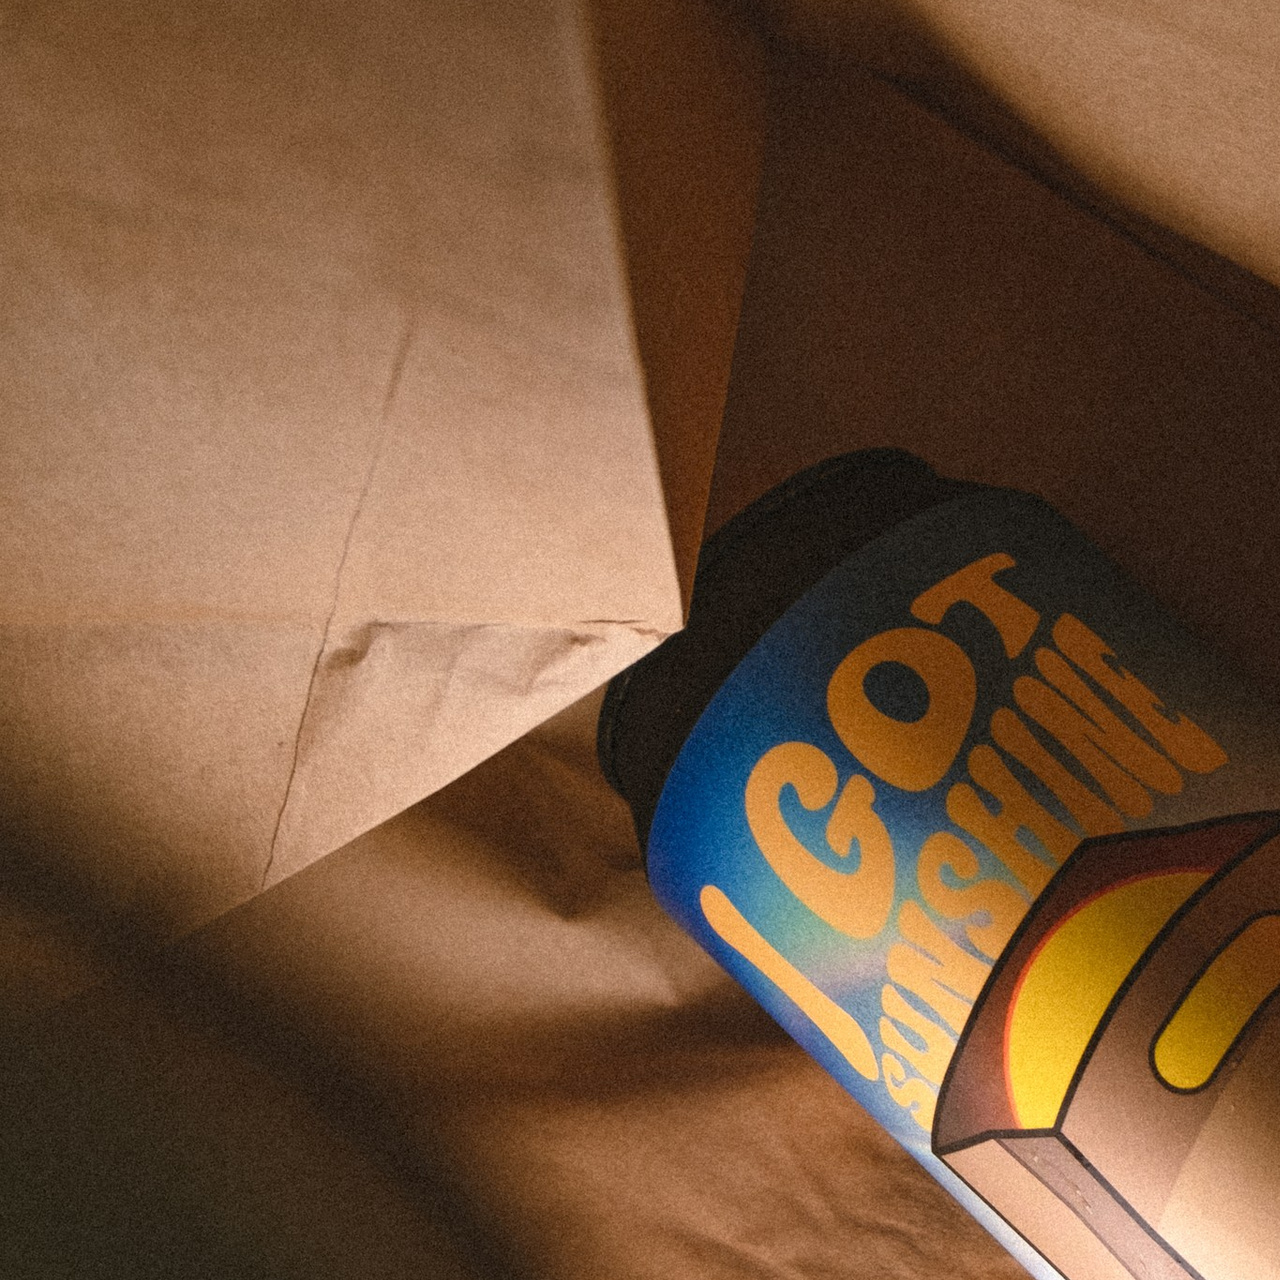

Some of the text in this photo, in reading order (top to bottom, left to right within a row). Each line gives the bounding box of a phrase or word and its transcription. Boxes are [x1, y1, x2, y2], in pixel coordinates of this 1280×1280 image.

[699, 552, 1041, 1081] I GOT
[879, 612, 1229, 1133] SUNSHINE
